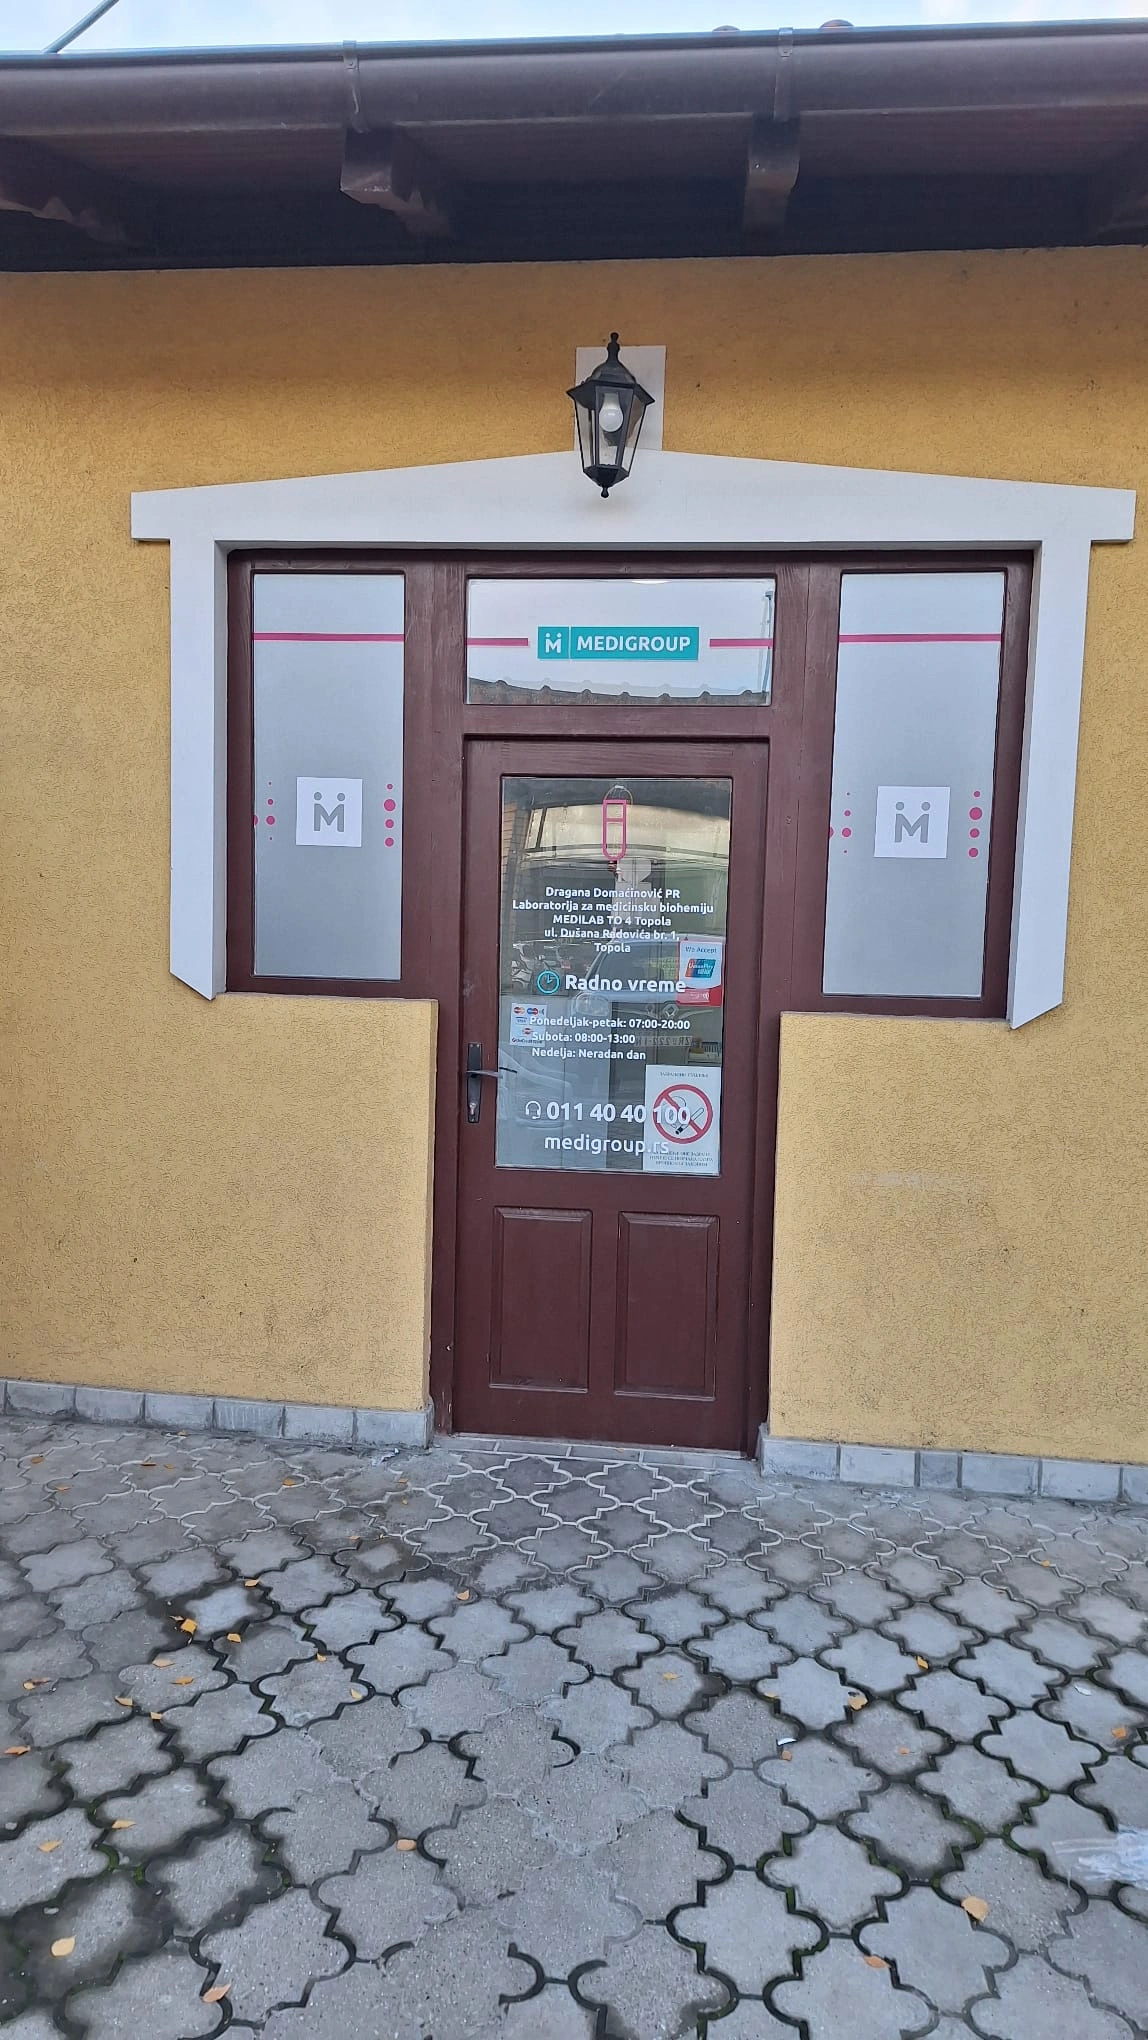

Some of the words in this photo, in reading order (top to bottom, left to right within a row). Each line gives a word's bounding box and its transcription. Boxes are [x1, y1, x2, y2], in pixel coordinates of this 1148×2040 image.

[577, 635, 690, 652] MEDIGROUP
[546, 887, 590, 899] Dragana
[593, 888, 662, 898] Domaćinović
[666, 890, 680, 899] PR
[513, 900, 578, 912] Laboratorija
[596, 902, 656, 912] medicinsku
[659, 903, 713, 914] biohemiju
[553, 915, 603, 925] MEDILAB
[607, 916, 622, 925] TO
[625, 916, 631, 925] 4
[635, 917, 671, 927] Topola
[544, 929, 557, 938] ul.
[561, 928, 599, 939] Dušana
[603, 929, 650, 939] Radovića
[653, 930, 668, 939] br.
[671, 931, 679, 941] 1,
[594, 943, 630, 953] Topola
[565, 975, 622, 991] Radno
[628, 979, 686, 992] vreme
[530, 1015, 626, 1029] Ponedeljak-petak:
[629, 1019, 690, 1029] 07:00-20:00
[532, 1032, 572, 1042] Subota:
[575, 1033, 635, 1043] 08:00-13:00
[532, 1048, 576, 1059] Nedelja:
[579, 1049, 624, 1059] Neradan
[627, 1049, 645, 1060] dan
[547, 1103, 583, 1120] 011
[590, 1104, 615, 1121] 40
[620, 1105, 647, 1122] 40
[654, 1106, 690, 1125] 100
[544, 1134, 669, 1154] medigroup.rs
